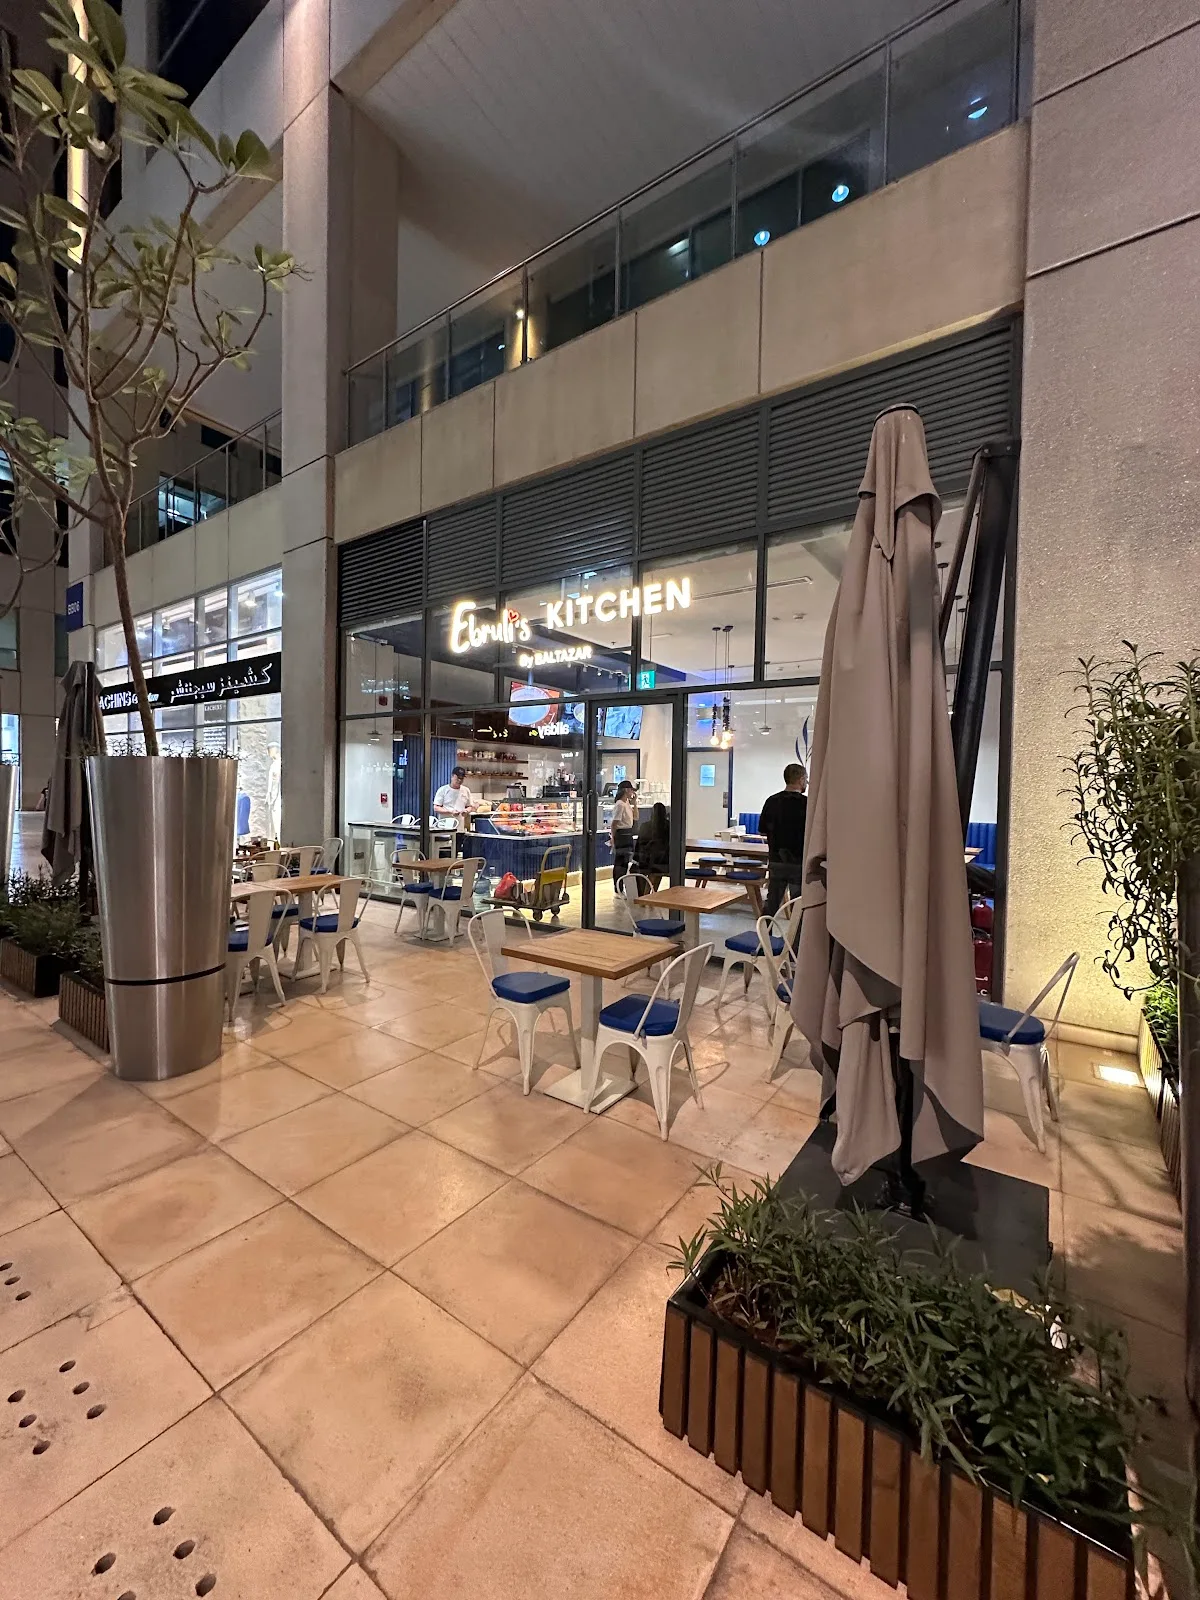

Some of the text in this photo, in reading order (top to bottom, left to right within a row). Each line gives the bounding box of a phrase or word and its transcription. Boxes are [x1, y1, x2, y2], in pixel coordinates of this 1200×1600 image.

[546, 577, 692, 629] KITCHEN
[535, 645, 592, 665] BALTAZAR
[98, 691, 132, 710] ACHINS
